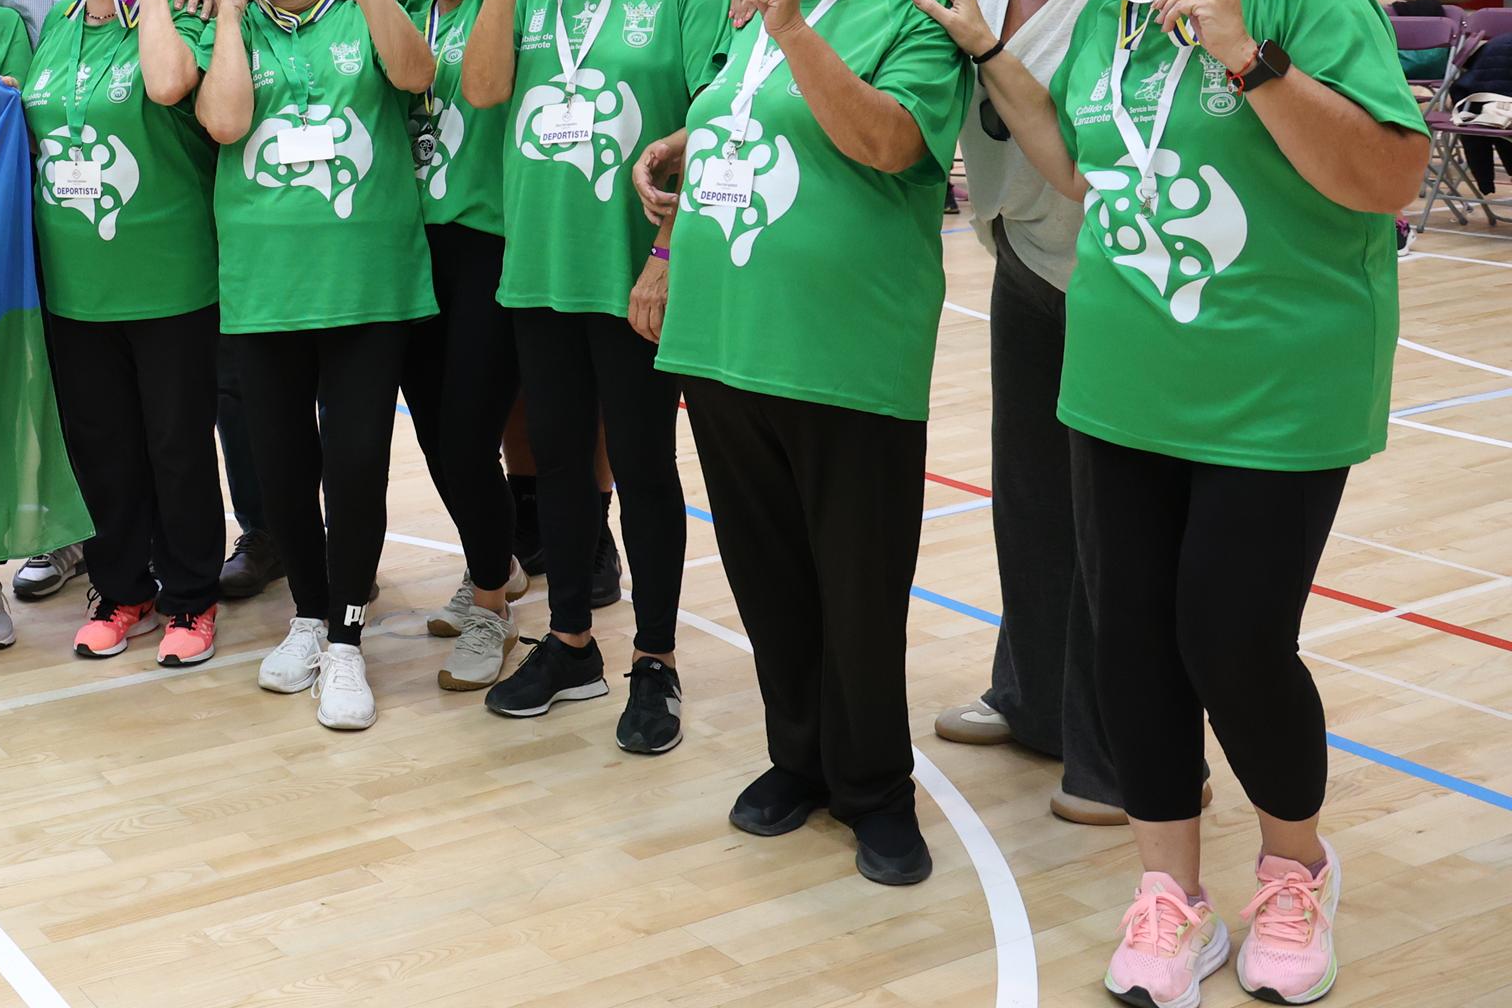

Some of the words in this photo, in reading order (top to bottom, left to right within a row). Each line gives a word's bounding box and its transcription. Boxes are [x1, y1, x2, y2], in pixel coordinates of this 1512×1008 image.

[542, 130, 589, 141] DEPORTISTA
[56, 187, 99, 195] DEPORTISTA
[700, 190, 747, 203] DEPORTISTA
